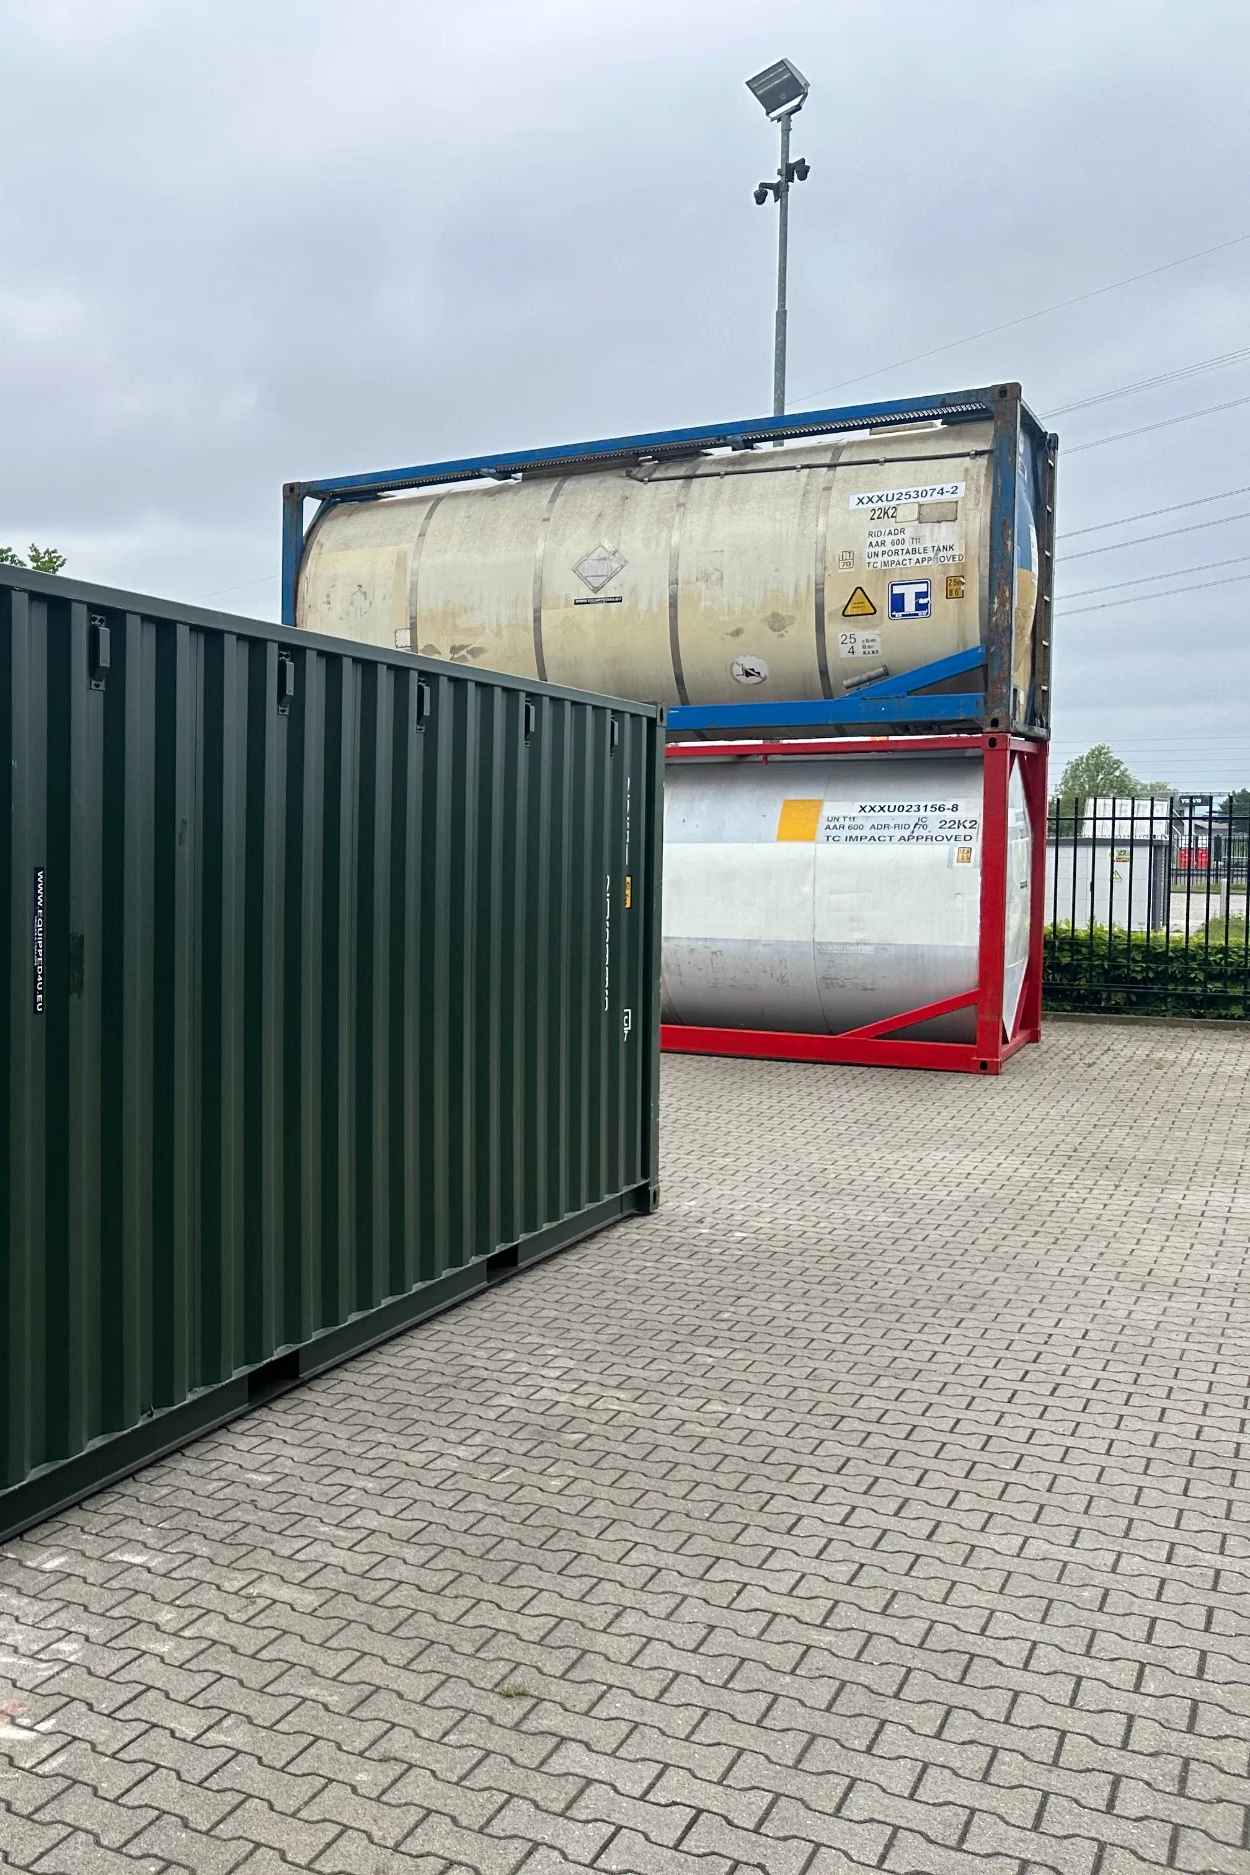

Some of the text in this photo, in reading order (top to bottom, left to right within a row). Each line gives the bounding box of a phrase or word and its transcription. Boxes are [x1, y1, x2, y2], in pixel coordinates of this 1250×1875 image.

[856, 485, 959, 506] XXXU253074-2
[869, 506, 897, 521] 22K2
[867, 527, 906, 539] RID/ADR
[867, 539, 887, 549] AAR
[890, 538, 906, 547] 600
[867, 544, 955, 559] UN PORTABLE TANK
[866, 561, 879, 569] TC
[880, 558, 913, 568] IMPACT
[840, 633, 857, 645] 25
[847, 645, 855, 656] 4
[858, 803, 959, 814] XXXU023156-8
[824, 823, 845, 831] AAR
[847, 823, 864, 831] 600
[938, 819, 978, 830] 22K2
[825, 833, 973, 843] TC IMPACT APPROVED
